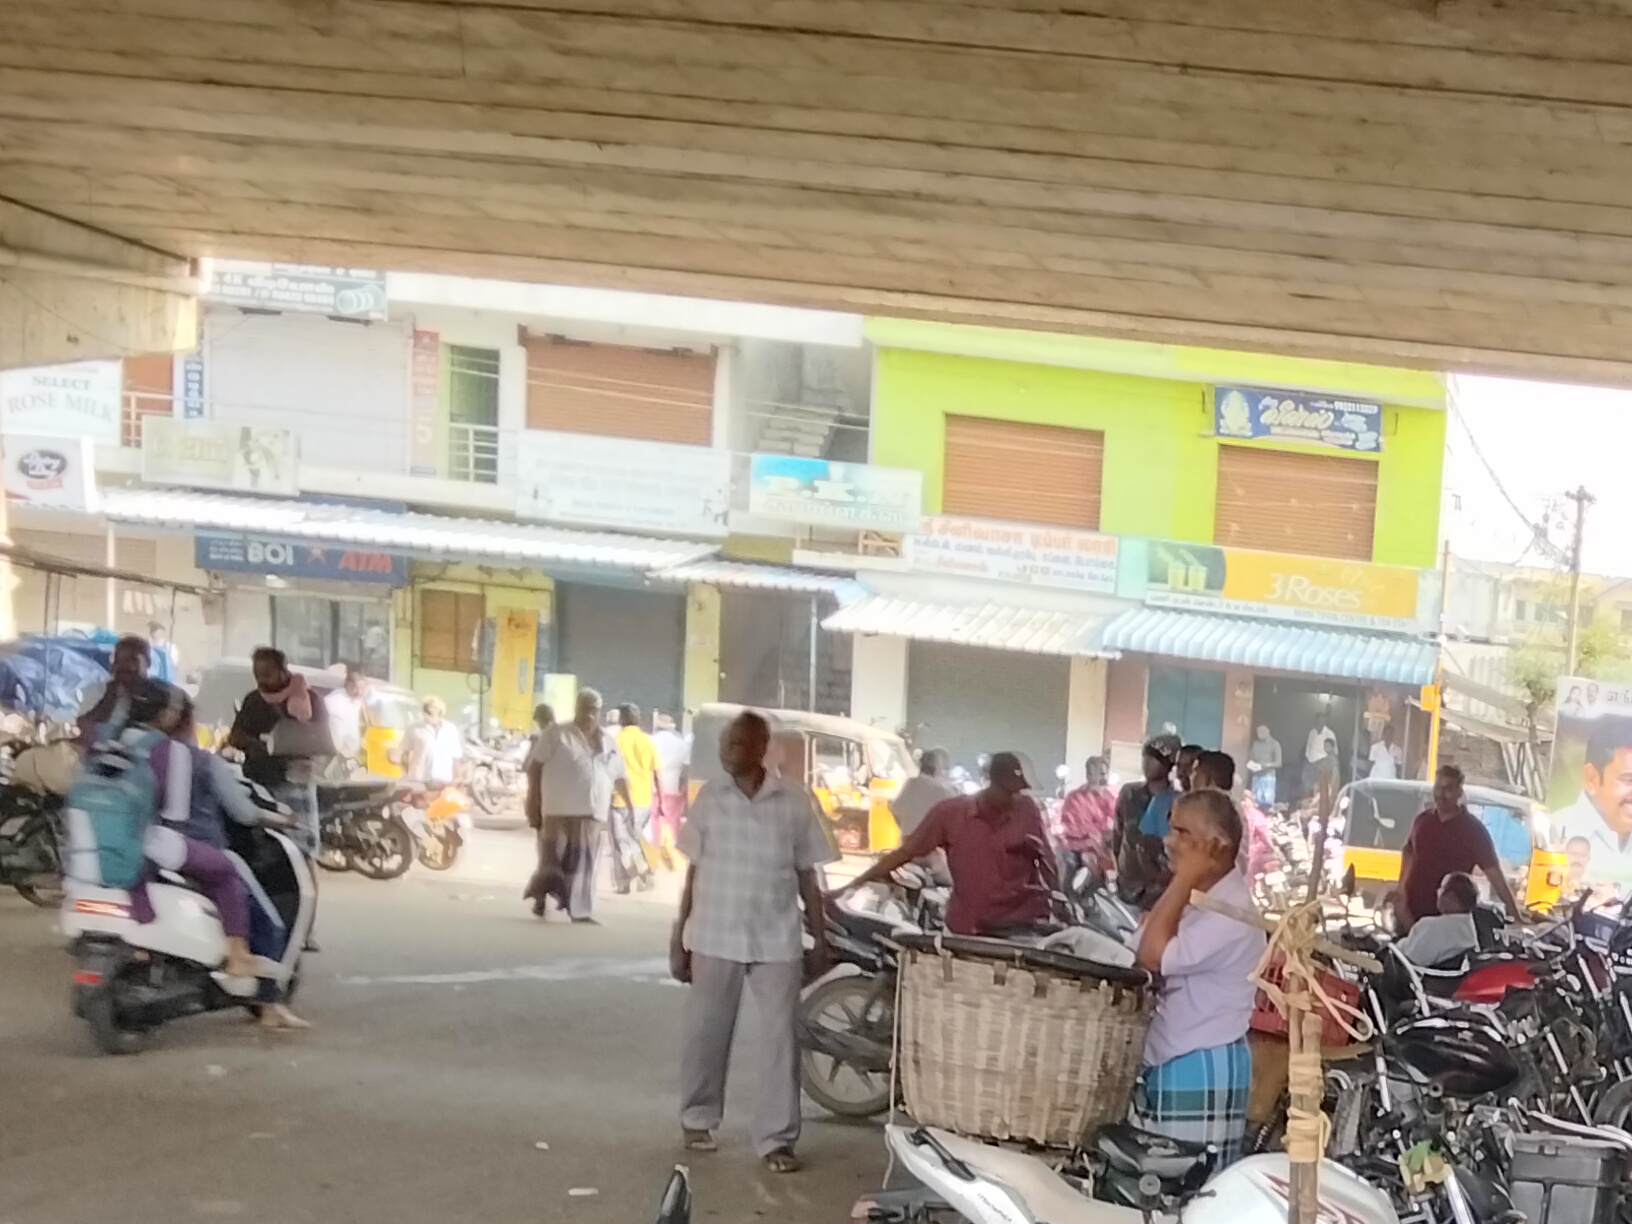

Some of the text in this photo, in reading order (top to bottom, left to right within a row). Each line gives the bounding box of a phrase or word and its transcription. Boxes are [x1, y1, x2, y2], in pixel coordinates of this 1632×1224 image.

[32, 374, 91, 391] SELECT
[8, 392, 113, 424] ROSE MILK
[247, 540, 294, 566] BOI
[338, 549, 394, 574] ATM
[1287, 575, 1363, 610] Roses
